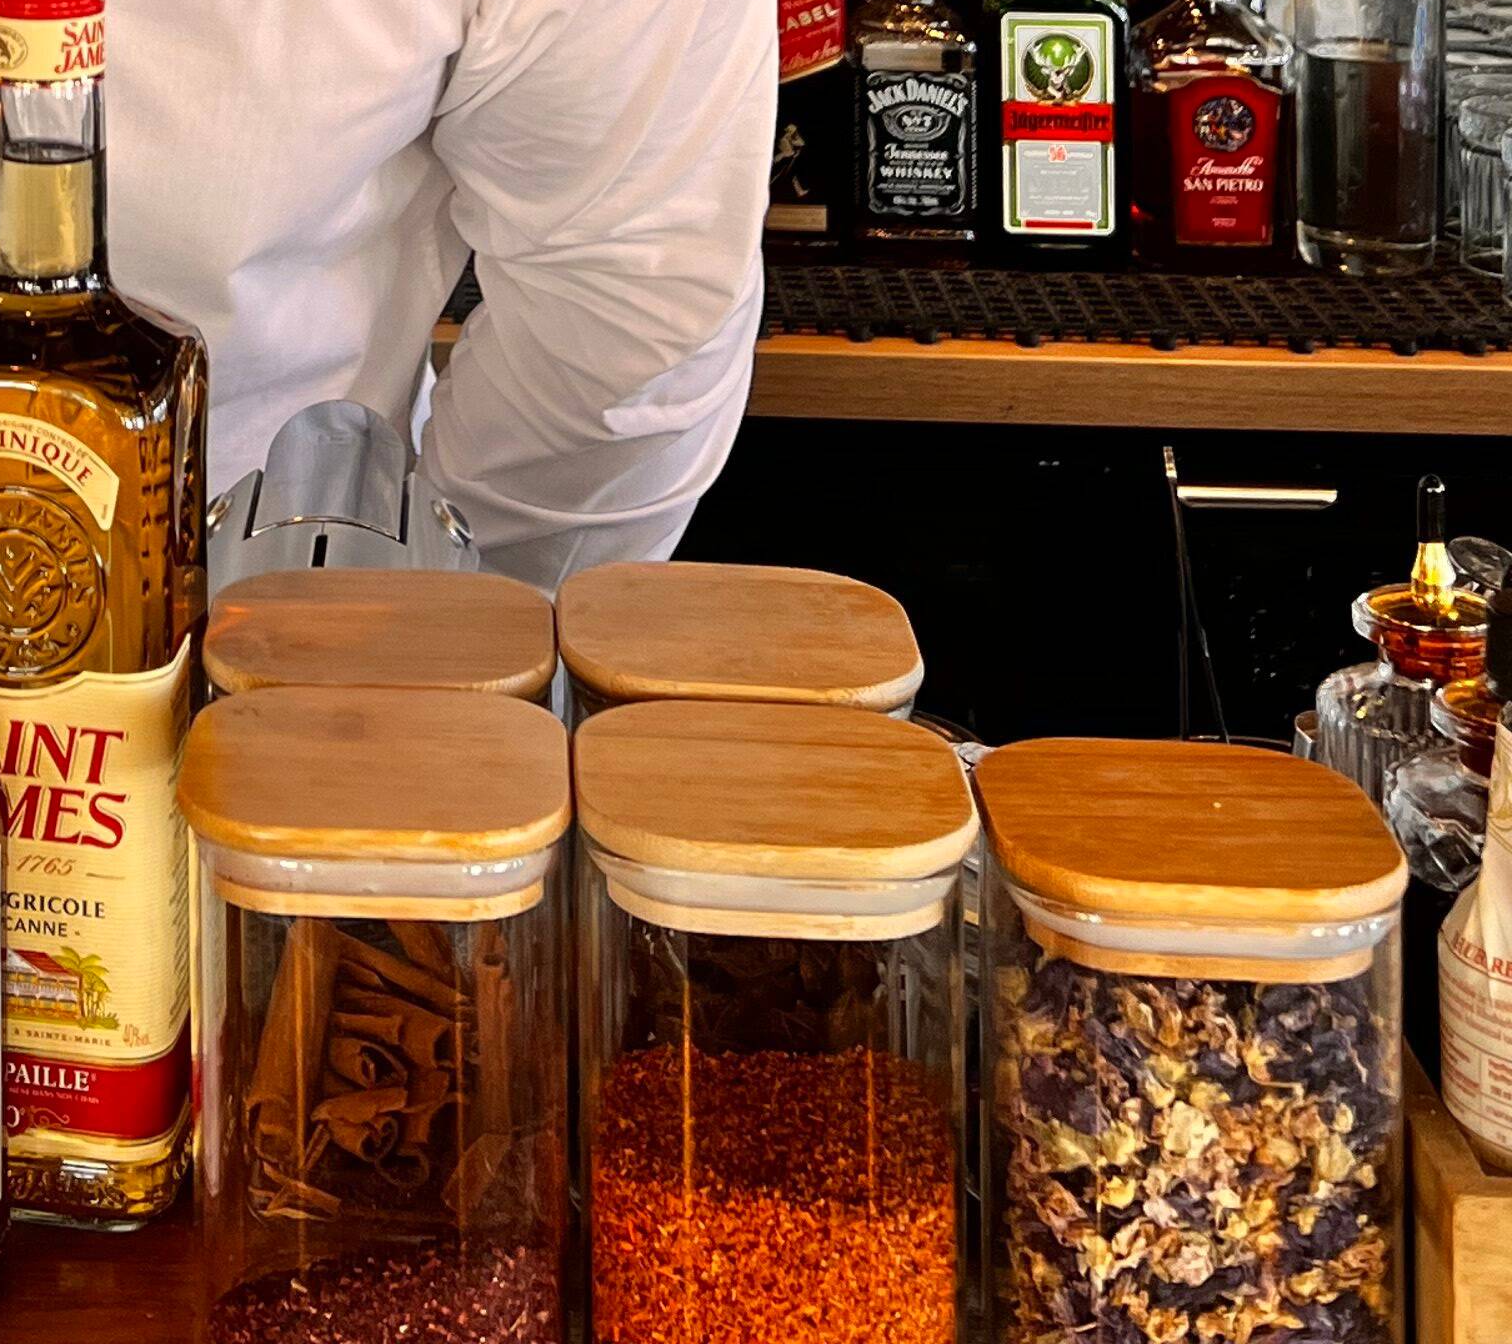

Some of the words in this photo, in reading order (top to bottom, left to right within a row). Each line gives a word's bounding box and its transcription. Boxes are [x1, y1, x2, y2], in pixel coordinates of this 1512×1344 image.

[867, 82, 908, 115] JACK
[904, 77, 969, 118] DANIEL'S
[879, 164, 955, 180] WHISKEY
[1182, 176, 1214, 193] SAN
[1215, 177, 1265, 193] PIETRO
[16, 853, 78, 877] 1765
[25, 1029, 113, 1048] SAINTE-MARIE
